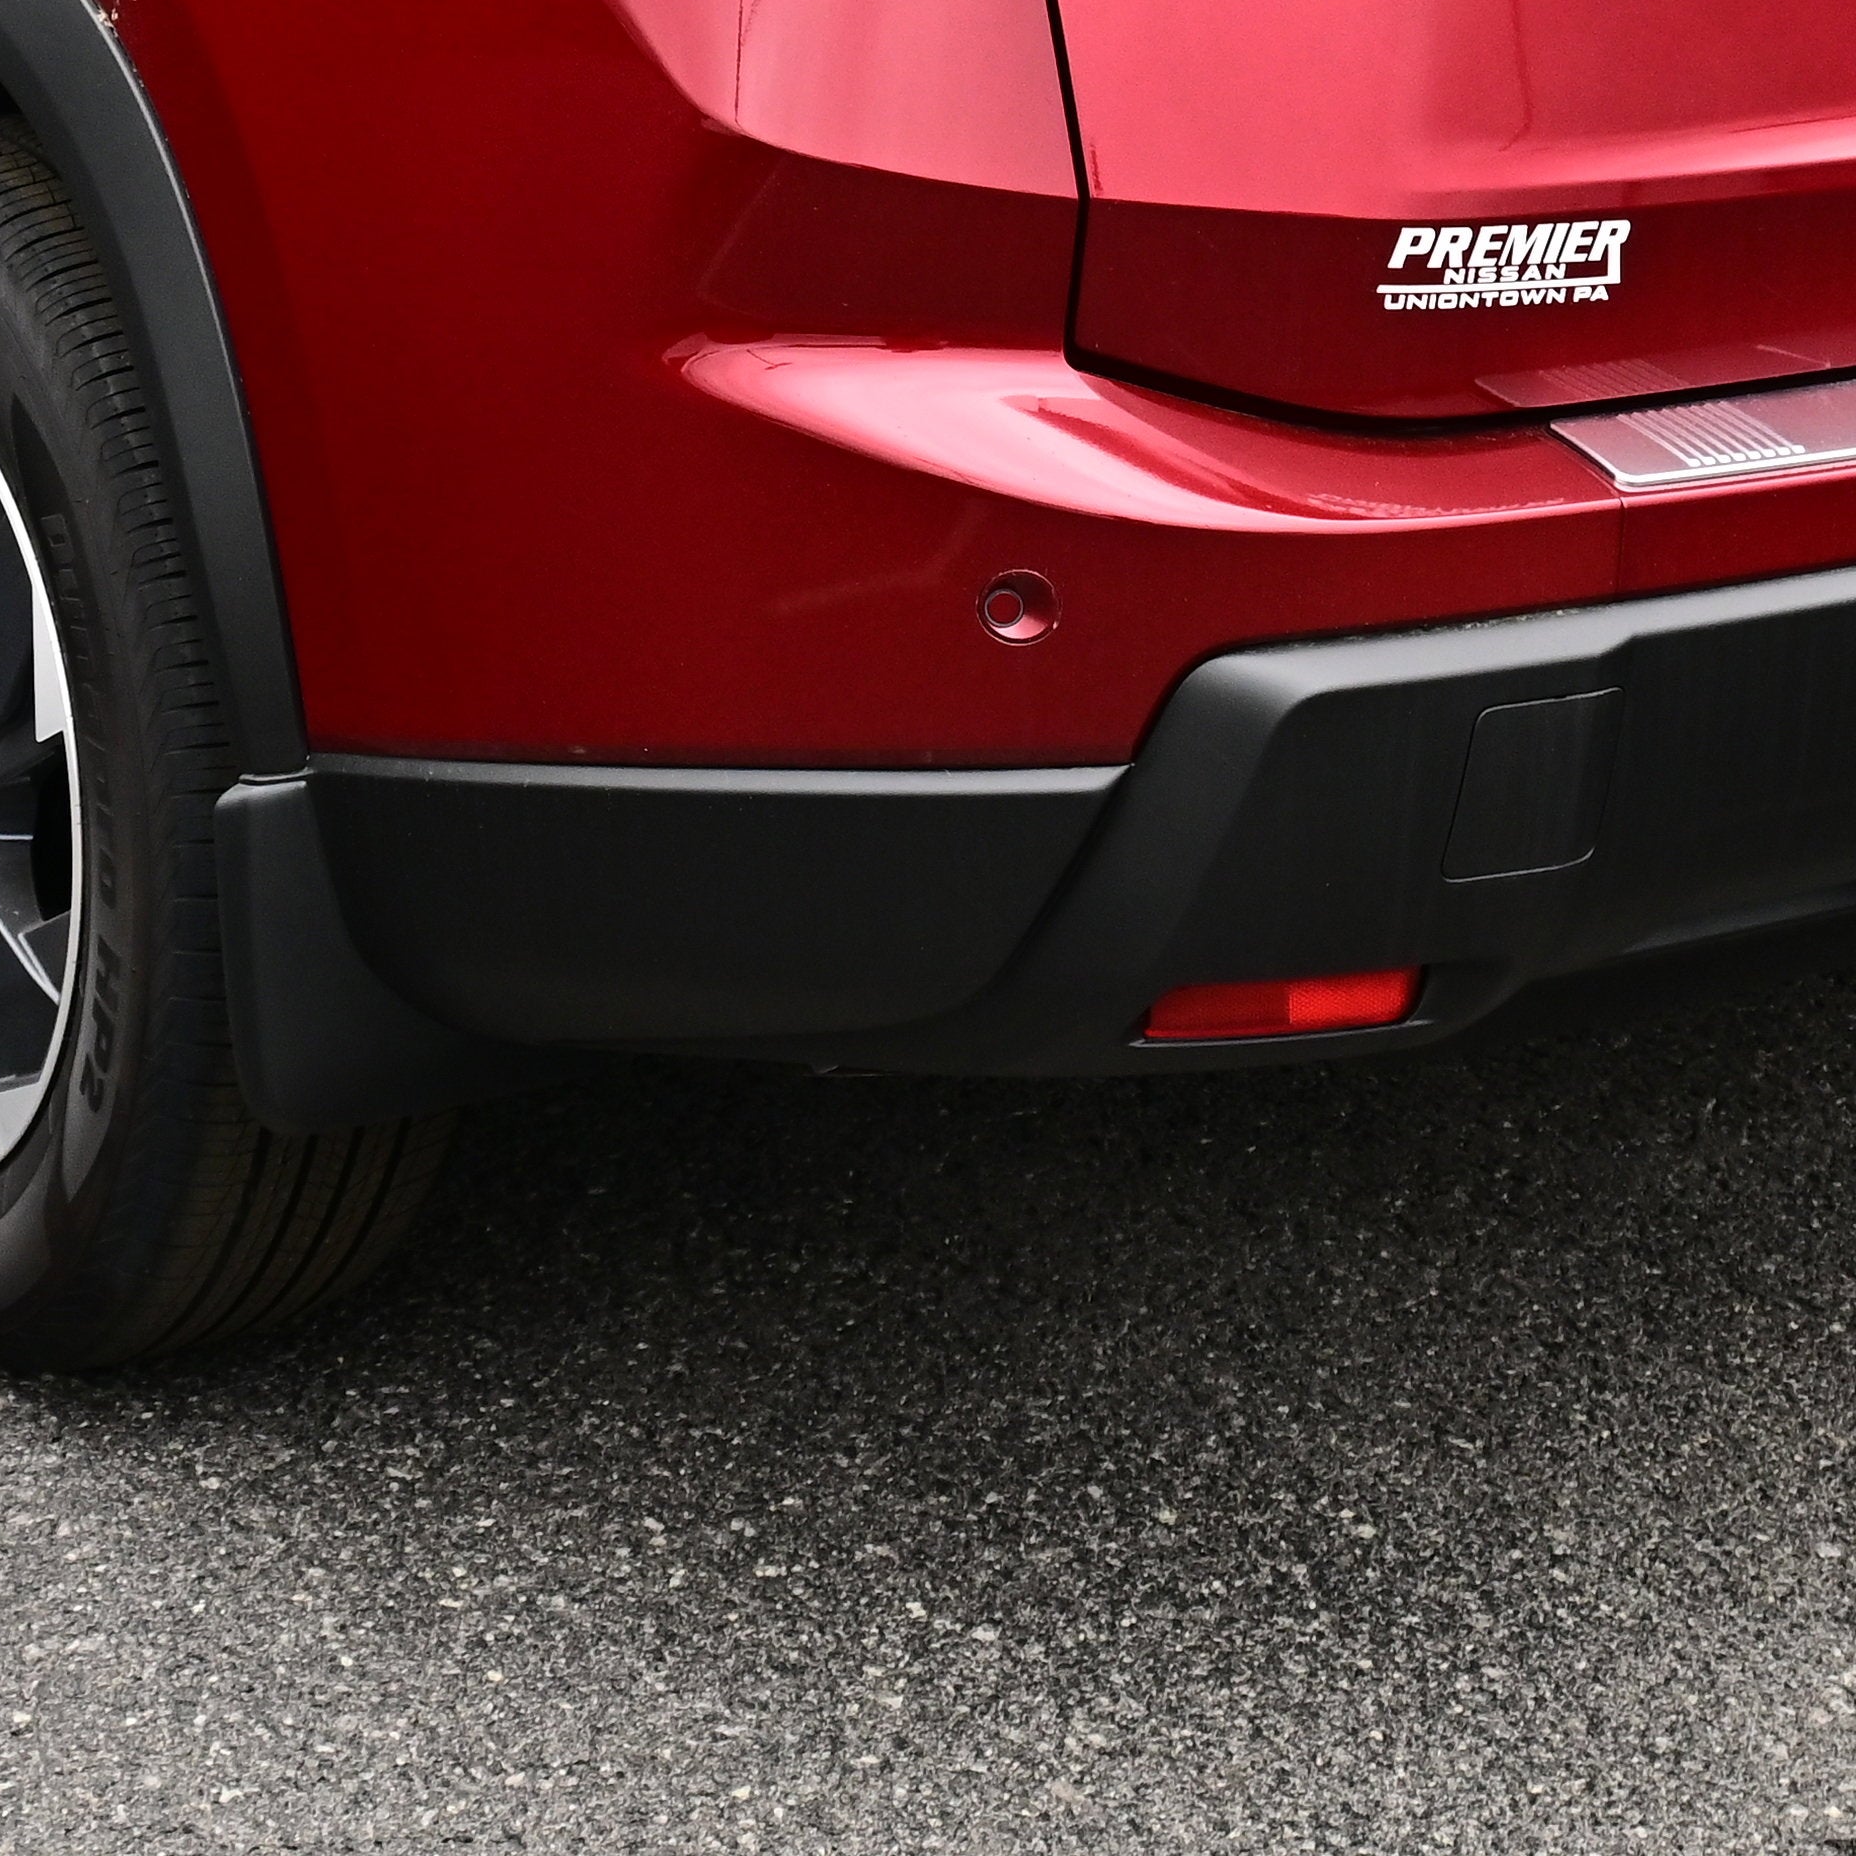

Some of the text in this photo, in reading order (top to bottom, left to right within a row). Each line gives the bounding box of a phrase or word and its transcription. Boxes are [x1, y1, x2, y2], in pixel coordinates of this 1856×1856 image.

[1387, 219, 1631, 274] PREMIER
[1444, 263, 1566, 285] NISSAN
[1384, 285, 1609, 310] UNIONTOWN PA
